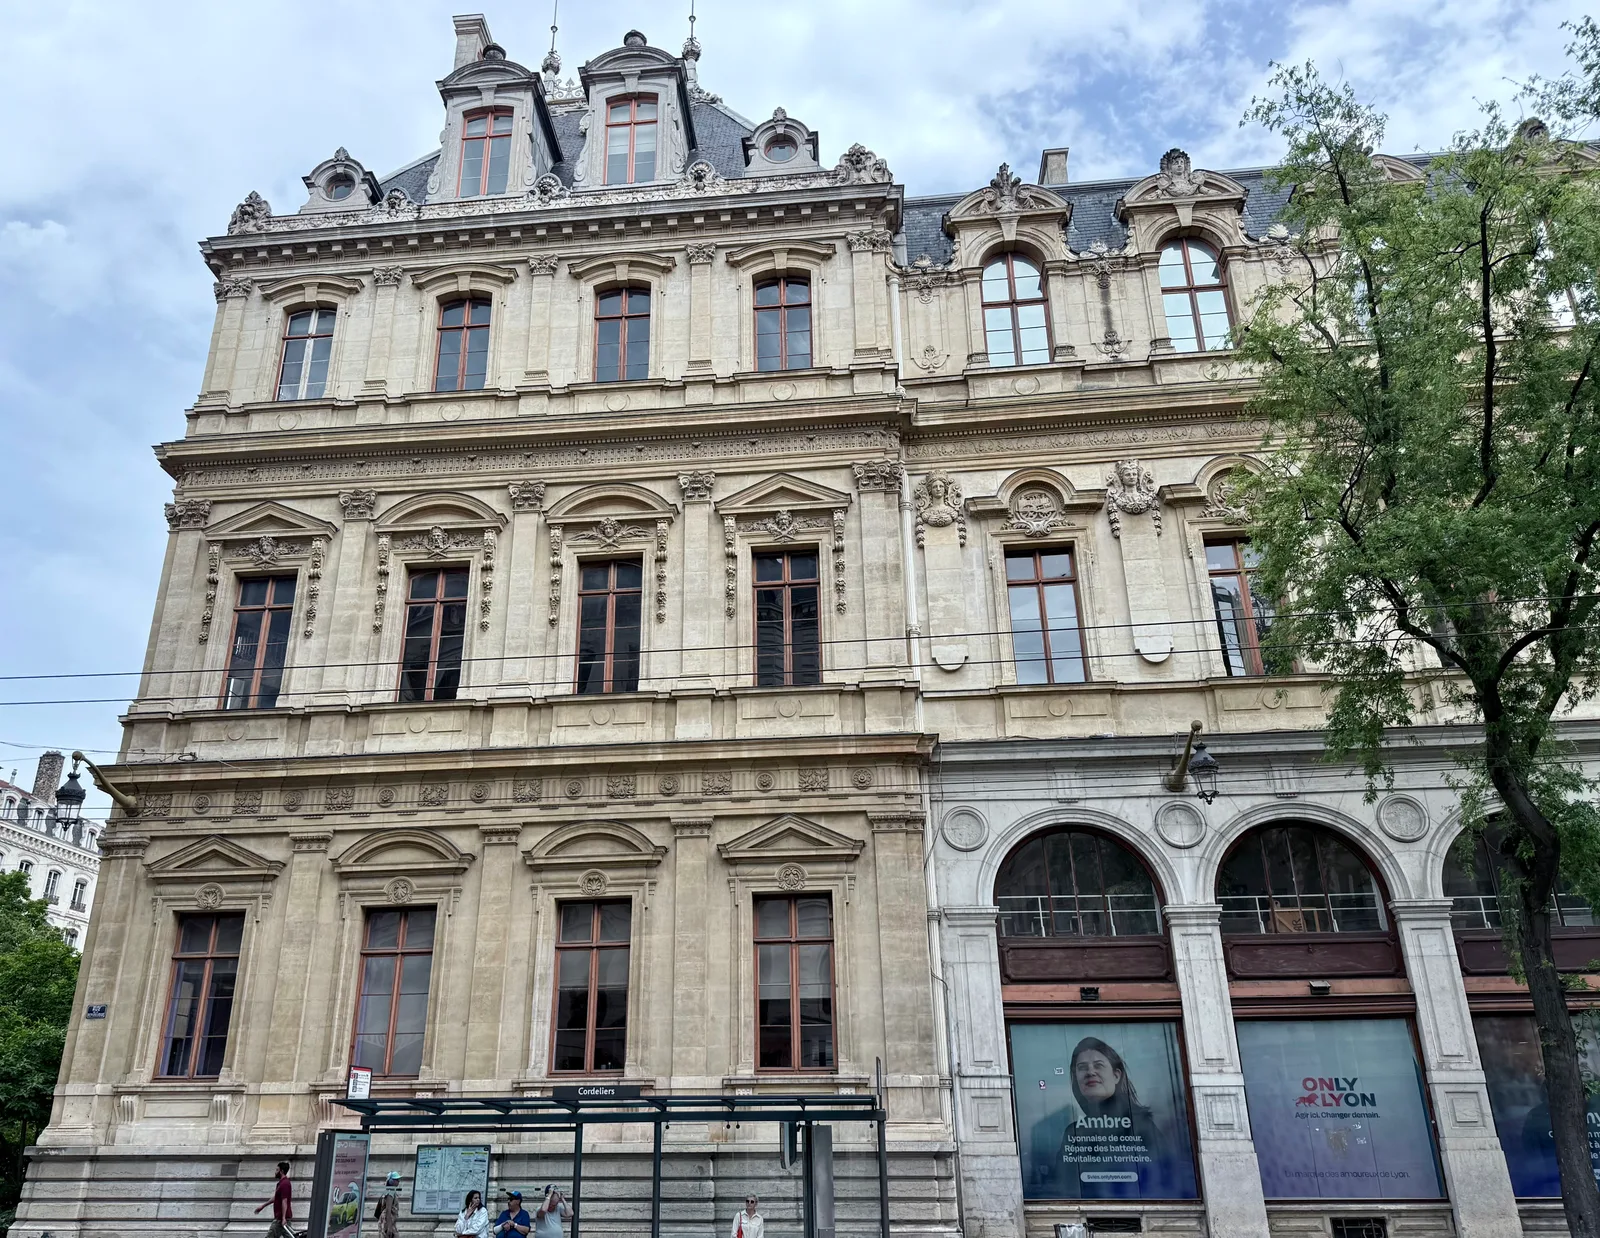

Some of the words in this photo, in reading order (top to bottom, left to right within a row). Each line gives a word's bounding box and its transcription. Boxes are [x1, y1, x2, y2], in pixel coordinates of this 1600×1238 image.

[1302, 1077, 1358, 1091] ONLY
[578, 1087, 615, 1095] Cordeliers
[1321, 1093, 1377, 1107] LYON
[1075, 1114, 1131, 1128] Ambre
[1067, 1134, 1107, 1143] Lyonnaise
[1064, 1144, 1093, 1153] Répare
[1380, 1170, 1390, 1178] de
